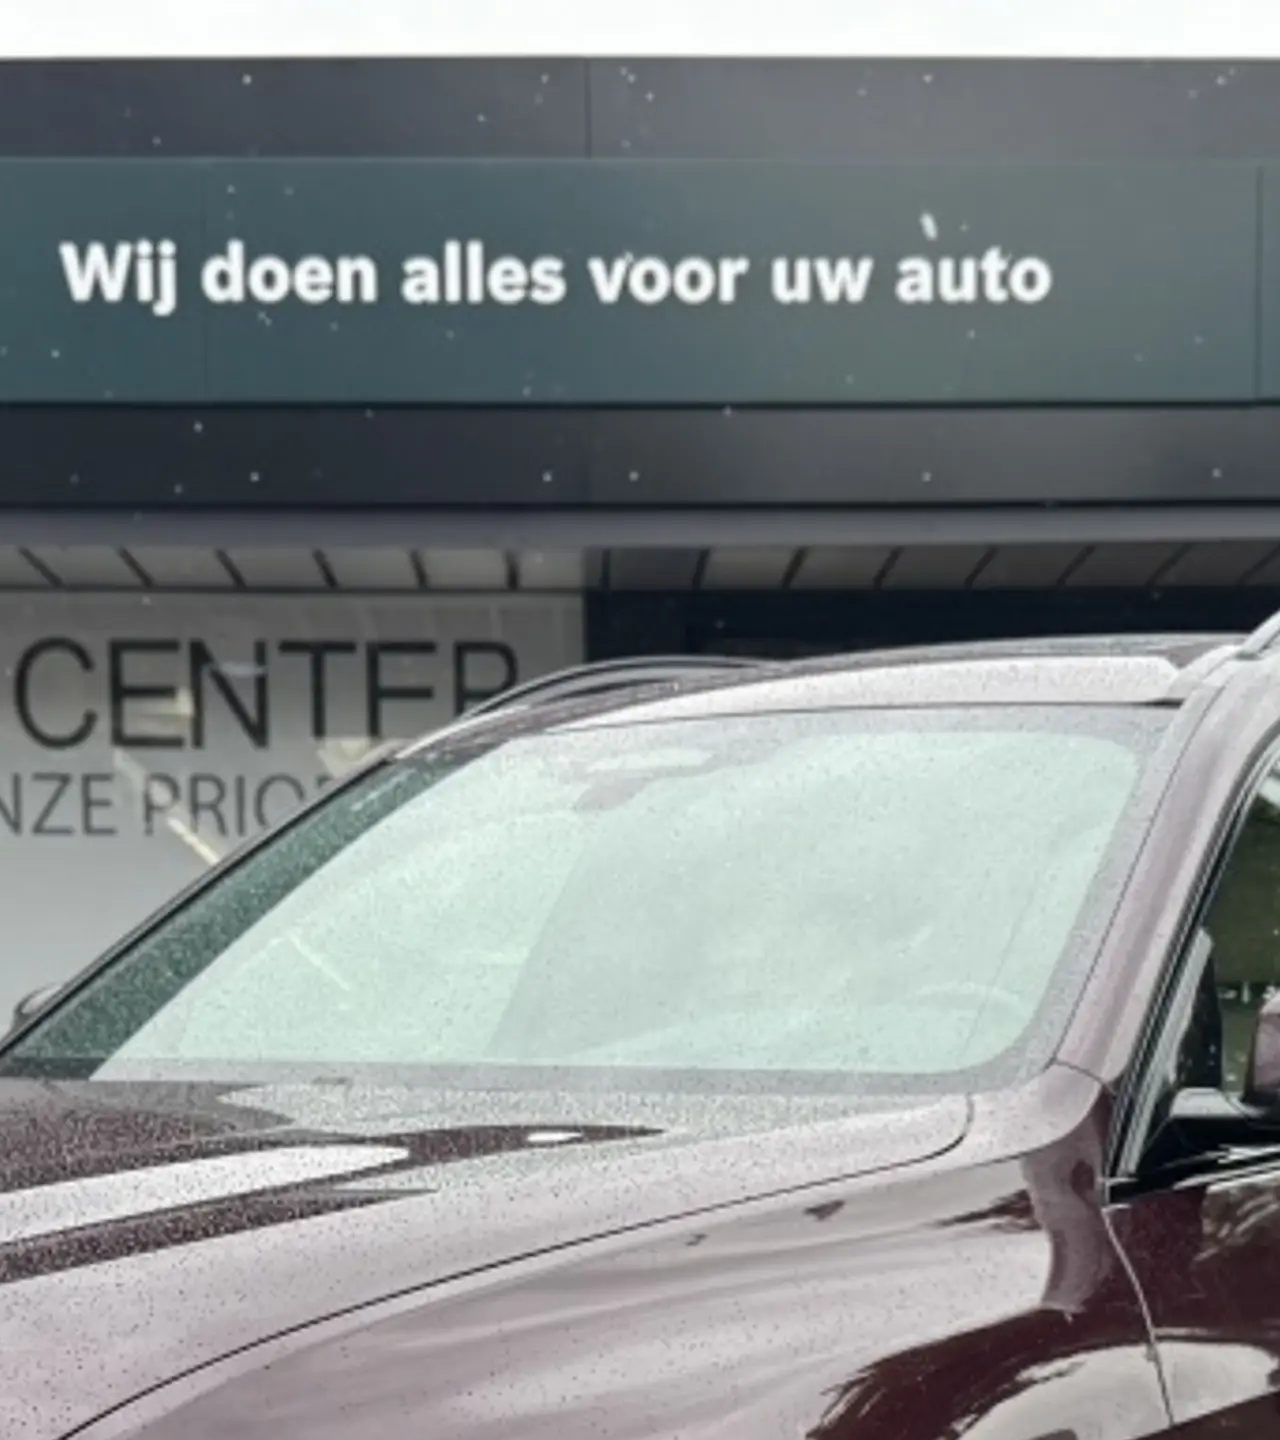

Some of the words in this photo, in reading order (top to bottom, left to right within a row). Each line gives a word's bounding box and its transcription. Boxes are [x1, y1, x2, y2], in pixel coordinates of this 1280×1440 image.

[59, 240, 177, 317] Wij
[201, 240, 378, 304] doen
[401, 240, 567, 305] alles
[588, 250, 751, 305] voor
[771, 254, 875, 305] uw
[895, 246, 1053, 305] auto
